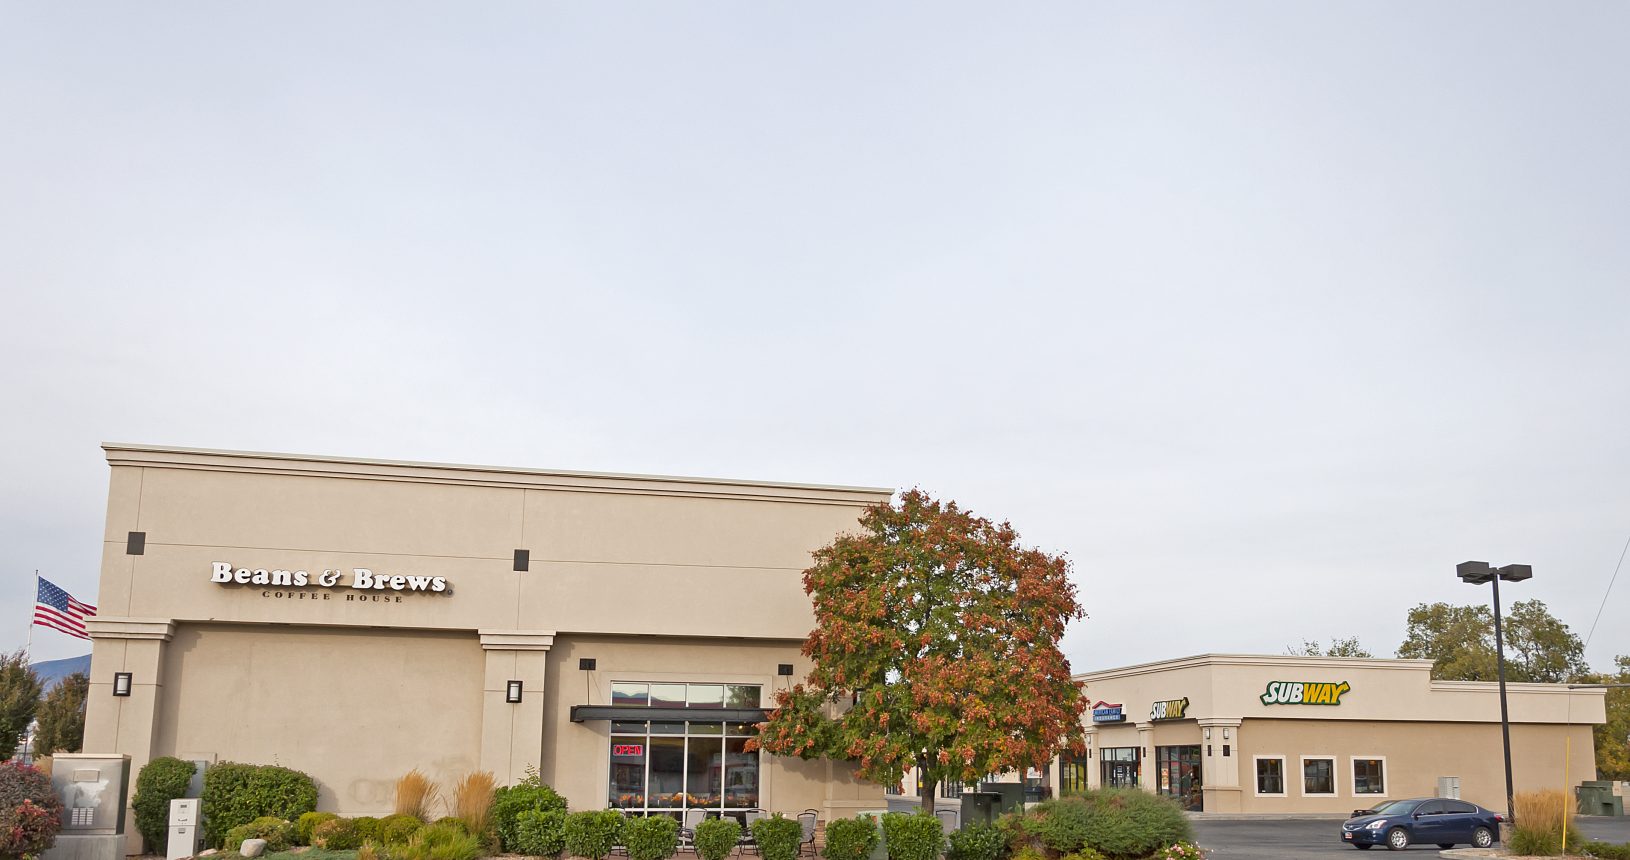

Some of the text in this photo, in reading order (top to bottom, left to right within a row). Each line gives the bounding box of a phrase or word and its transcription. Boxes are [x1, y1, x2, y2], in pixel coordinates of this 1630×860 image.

[210, 561, 447, 592] Beans & Brews
[262, 591, 402, 603] COFFEE HOUSE
[1262, 682, 1349, 704] SUBWAY
[1150, 699, 1187, 719] SUBWAY
[614, 745, 642, 755] OPEN
